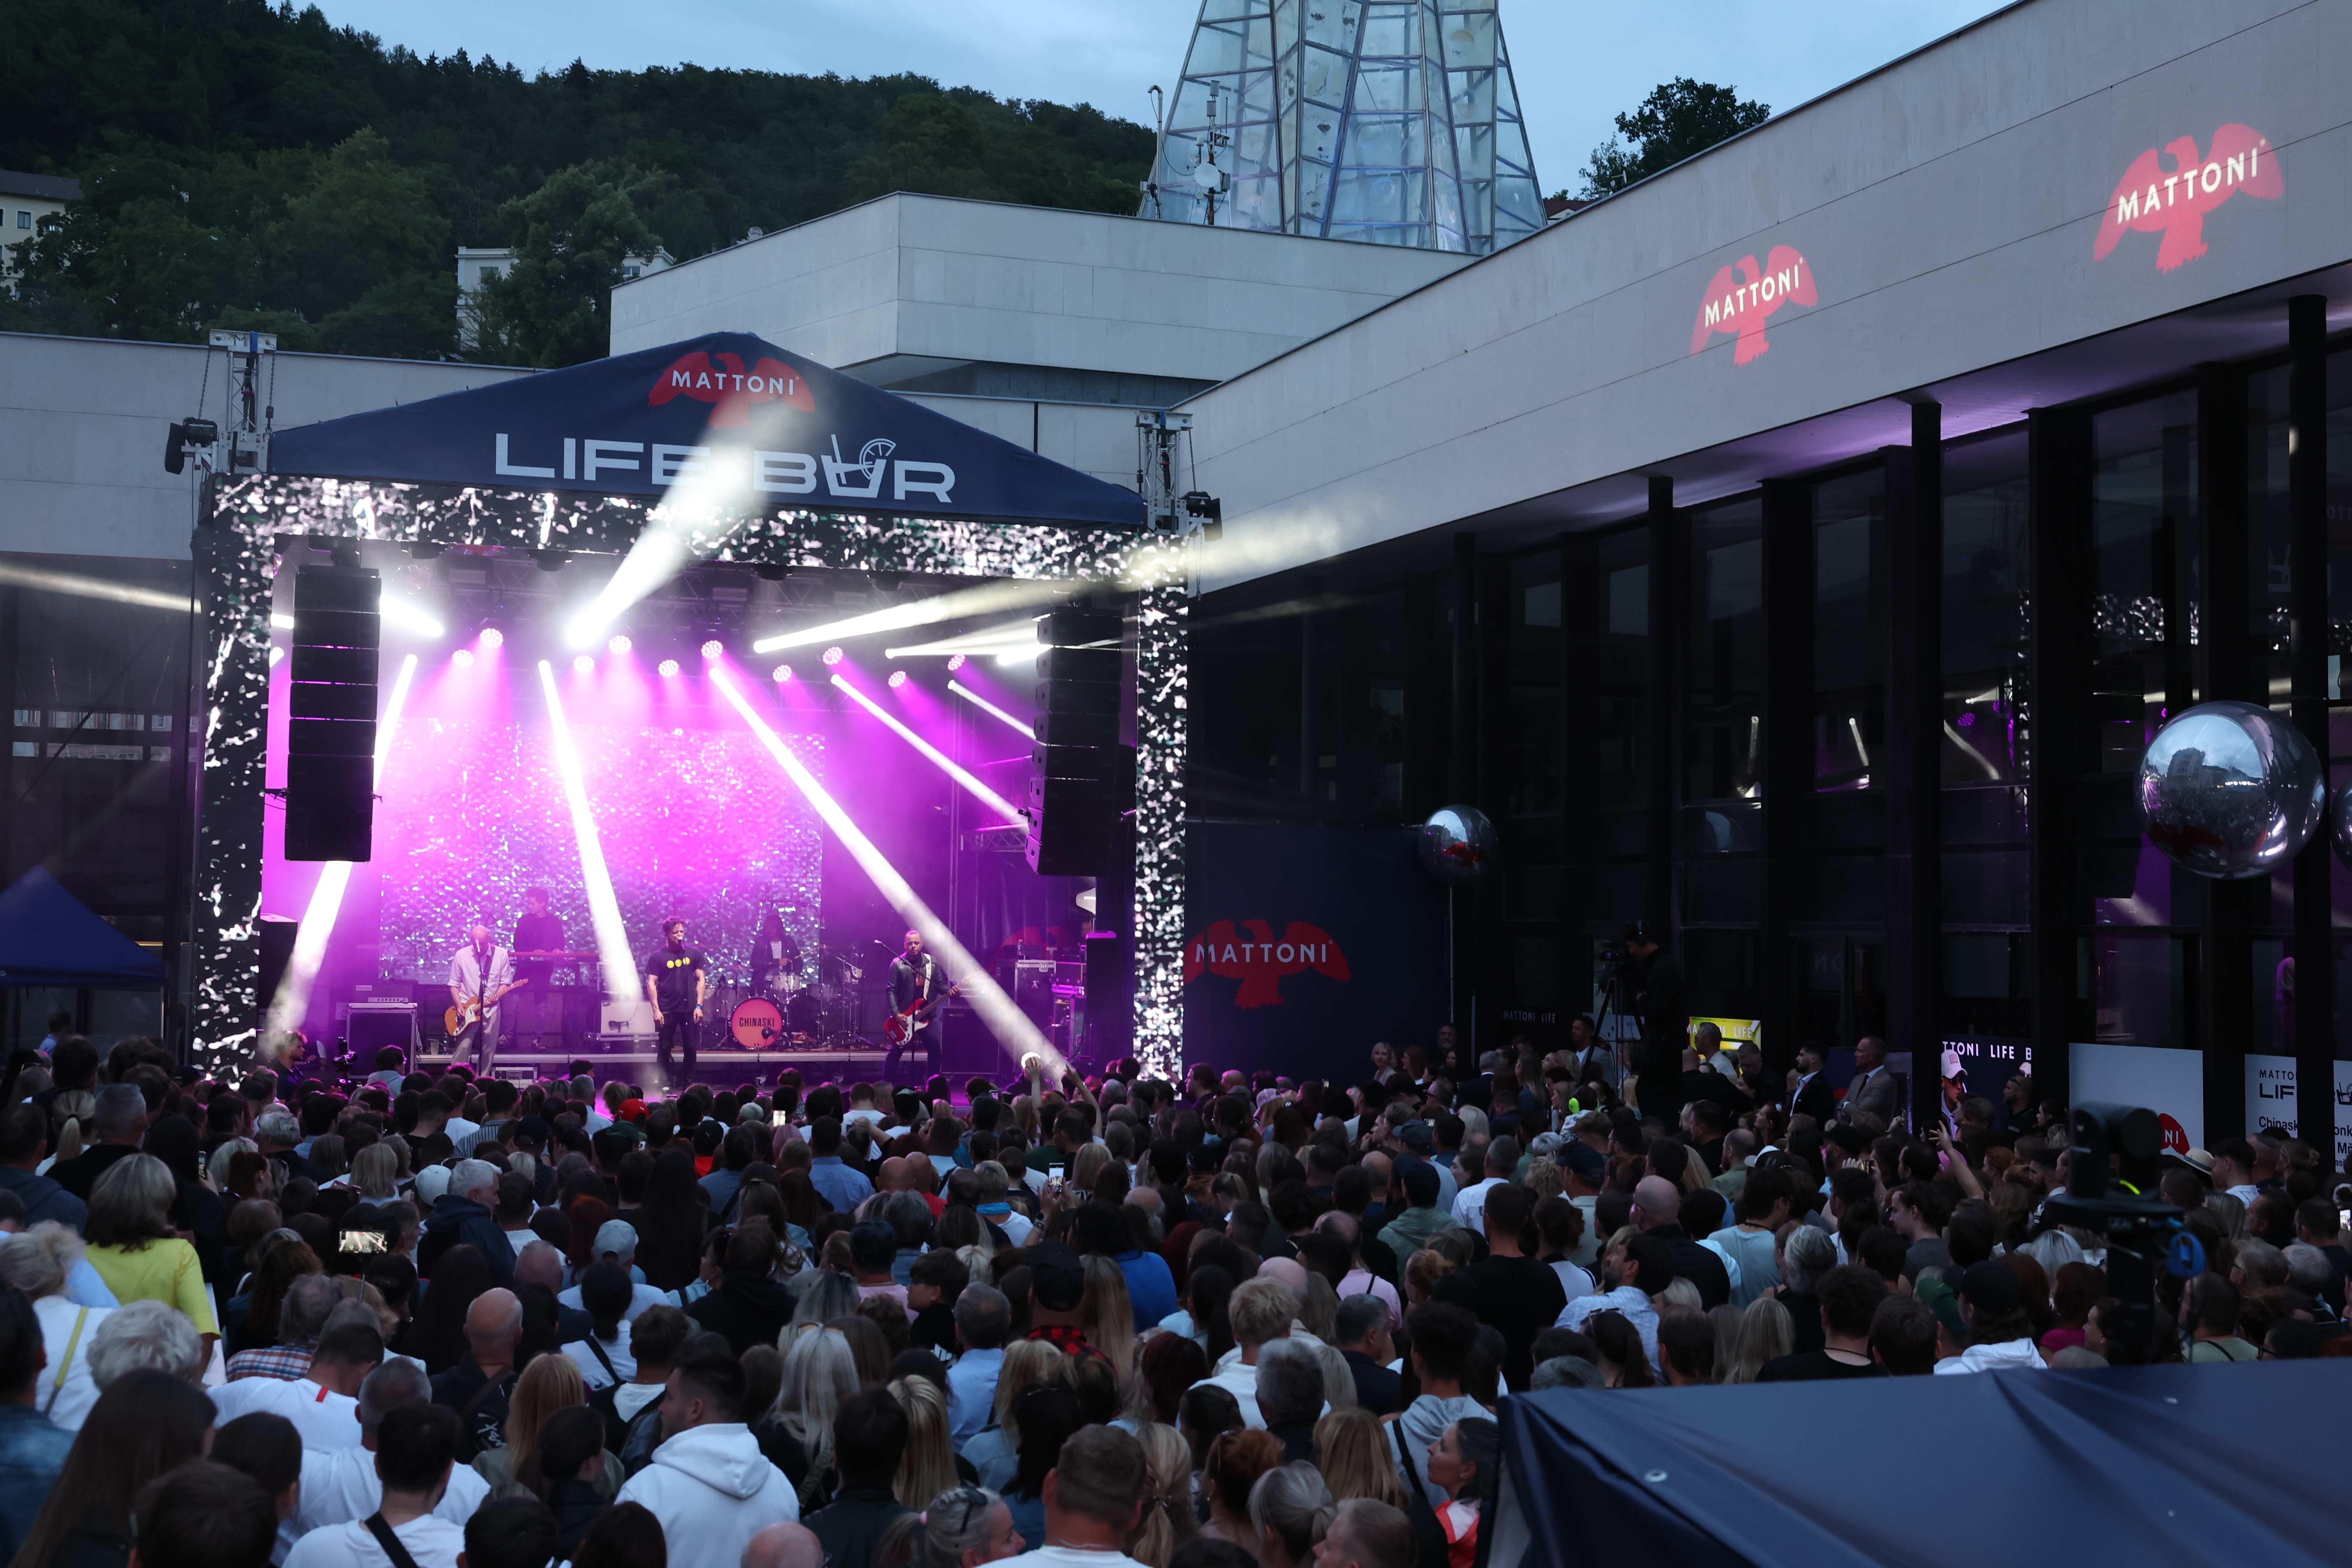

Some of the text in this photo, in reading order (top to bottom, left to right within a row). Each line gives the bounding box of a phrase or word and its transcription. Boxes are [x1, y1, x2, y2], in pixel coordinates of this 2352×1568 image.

[2117, 147, 2258, 224] MATTONI
[1705, 264, 1799, 328] MATTONI
[672, 370, 794, 395] MATTONI
[495, 433, 711, 487] LIFE
[1195, 943, 1326, 963] MATTONI
[739, 1017, 775, 1027] CHINASKI
[1503, 1010, 1556, 1024] MATTONI LIFE
[1734, 1026, 1752, 1038] LIFE
[1942, 1041, 1979, 1057] TTONI
[1990, 1044, 2015, 1059] LIFE
[2259, 1069, 2297, 1080] MATTO
[2259, 1083, 2294, 1099] LIF
[2259, 1116, 2298, 1131] Chinask
